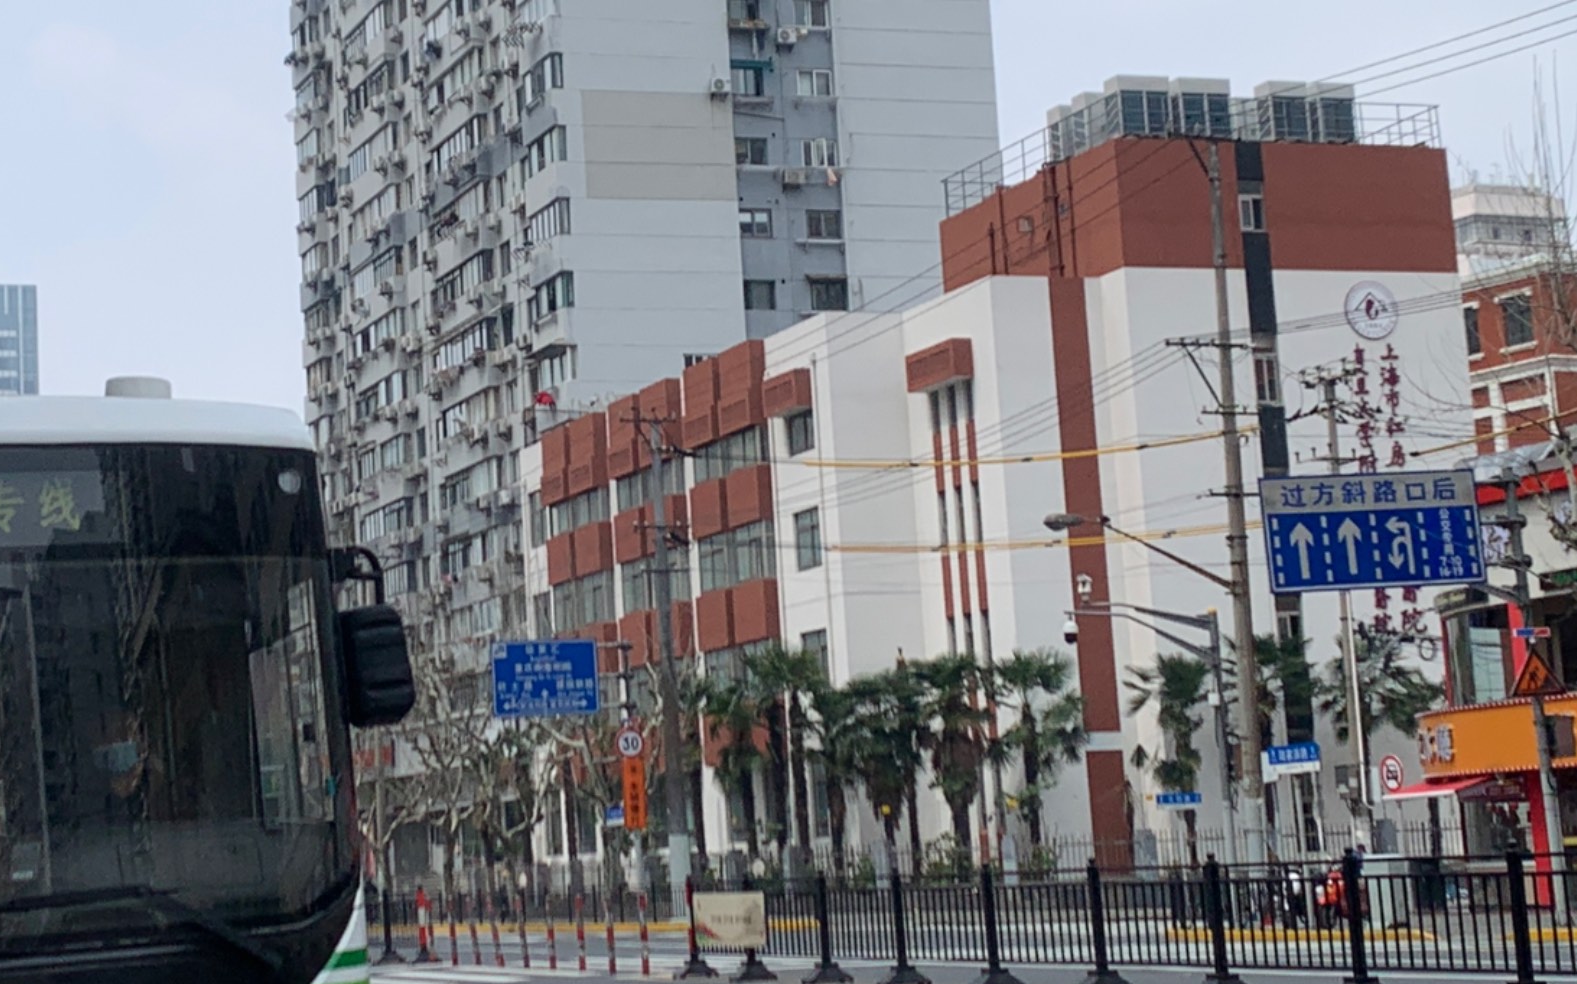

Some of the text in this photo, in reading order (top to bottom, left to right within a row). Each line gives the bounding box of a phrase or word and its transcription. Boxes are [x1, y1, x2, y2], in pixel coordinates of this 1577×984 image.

[1280, 476, 1457, 508] 过方斜路口后
[622, 735, 640, 752] 30
